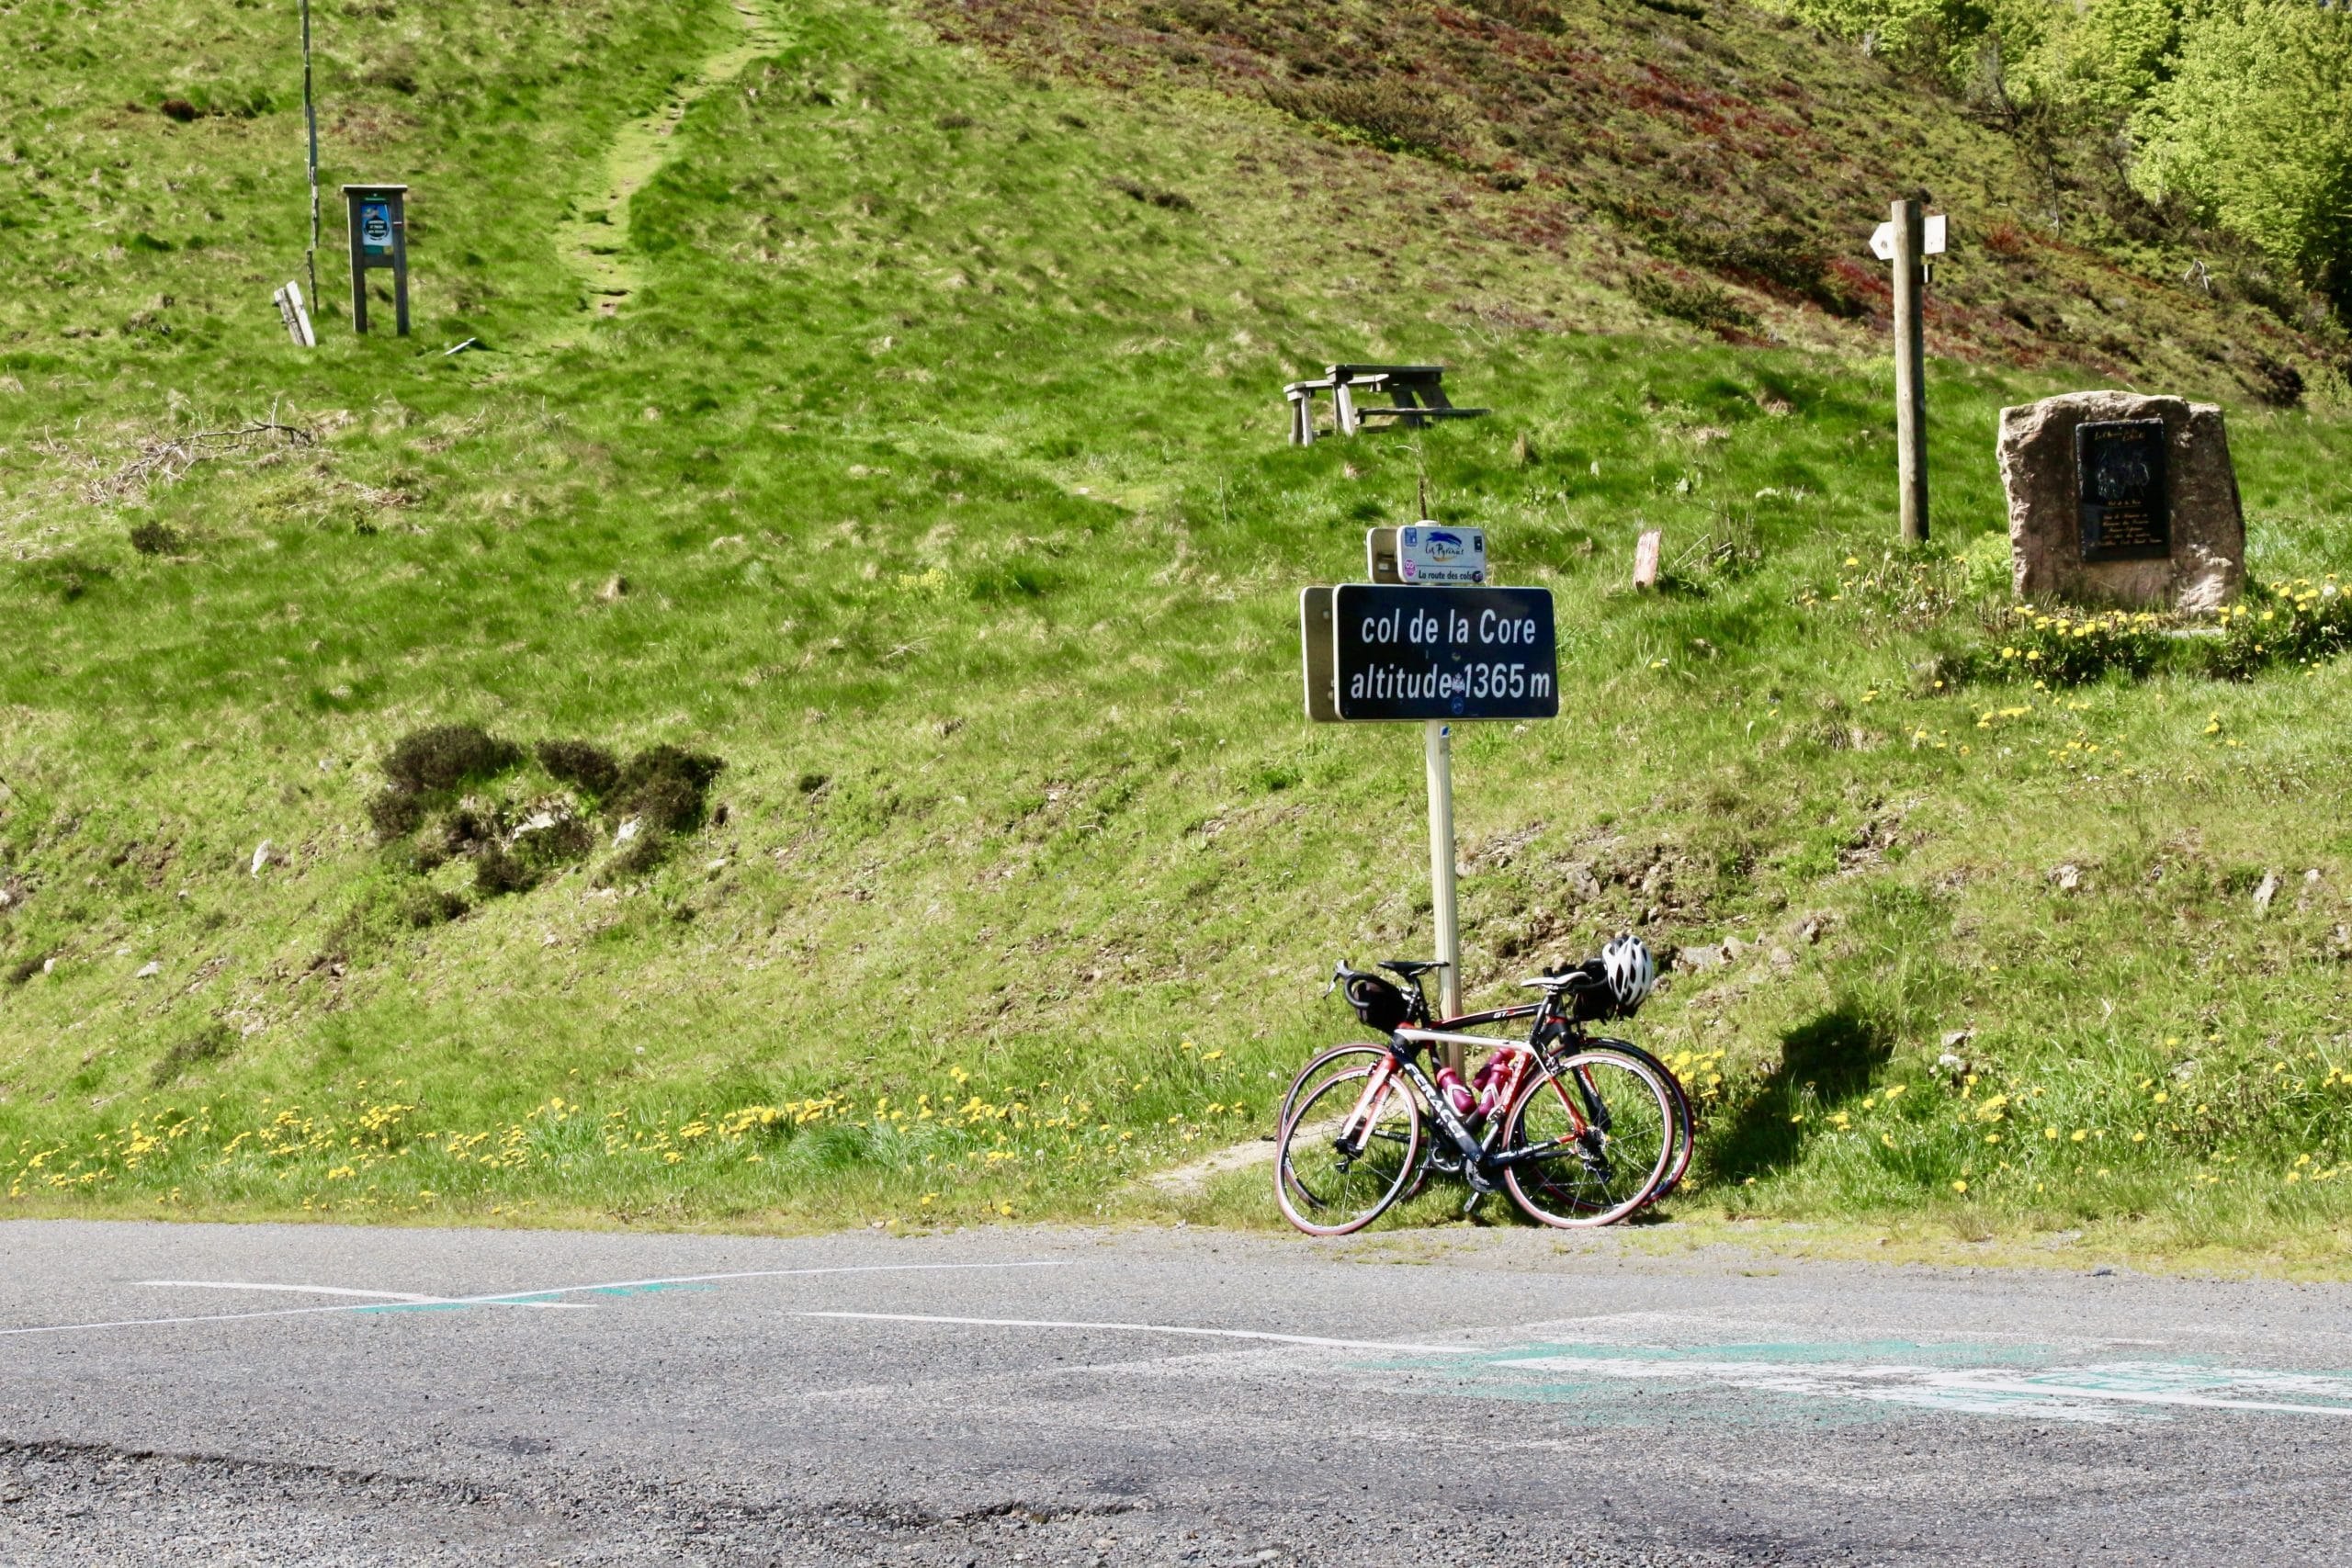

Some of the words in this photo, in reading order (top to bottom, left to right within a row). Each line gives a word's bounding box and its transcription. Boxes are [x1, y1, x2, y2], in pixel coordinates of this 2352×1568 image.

[1419, 570, 1426, 579] La
[1429, 571, 1444, 580] route
[1447, 570, 1458, 580] des
[1362, 608, 1400, 643] col
[1409, 608, 1439, 643] de
[1448, 609, 1469, 643] la
[1479, 608, 1536, 644] Core
[1351, 663, 1452, 699] altitude
[1464, 662, 1525, 698] 1365
[1530, 671, 1550, 697] m
[1403, 1063, 1466, 1139] FERACCI
